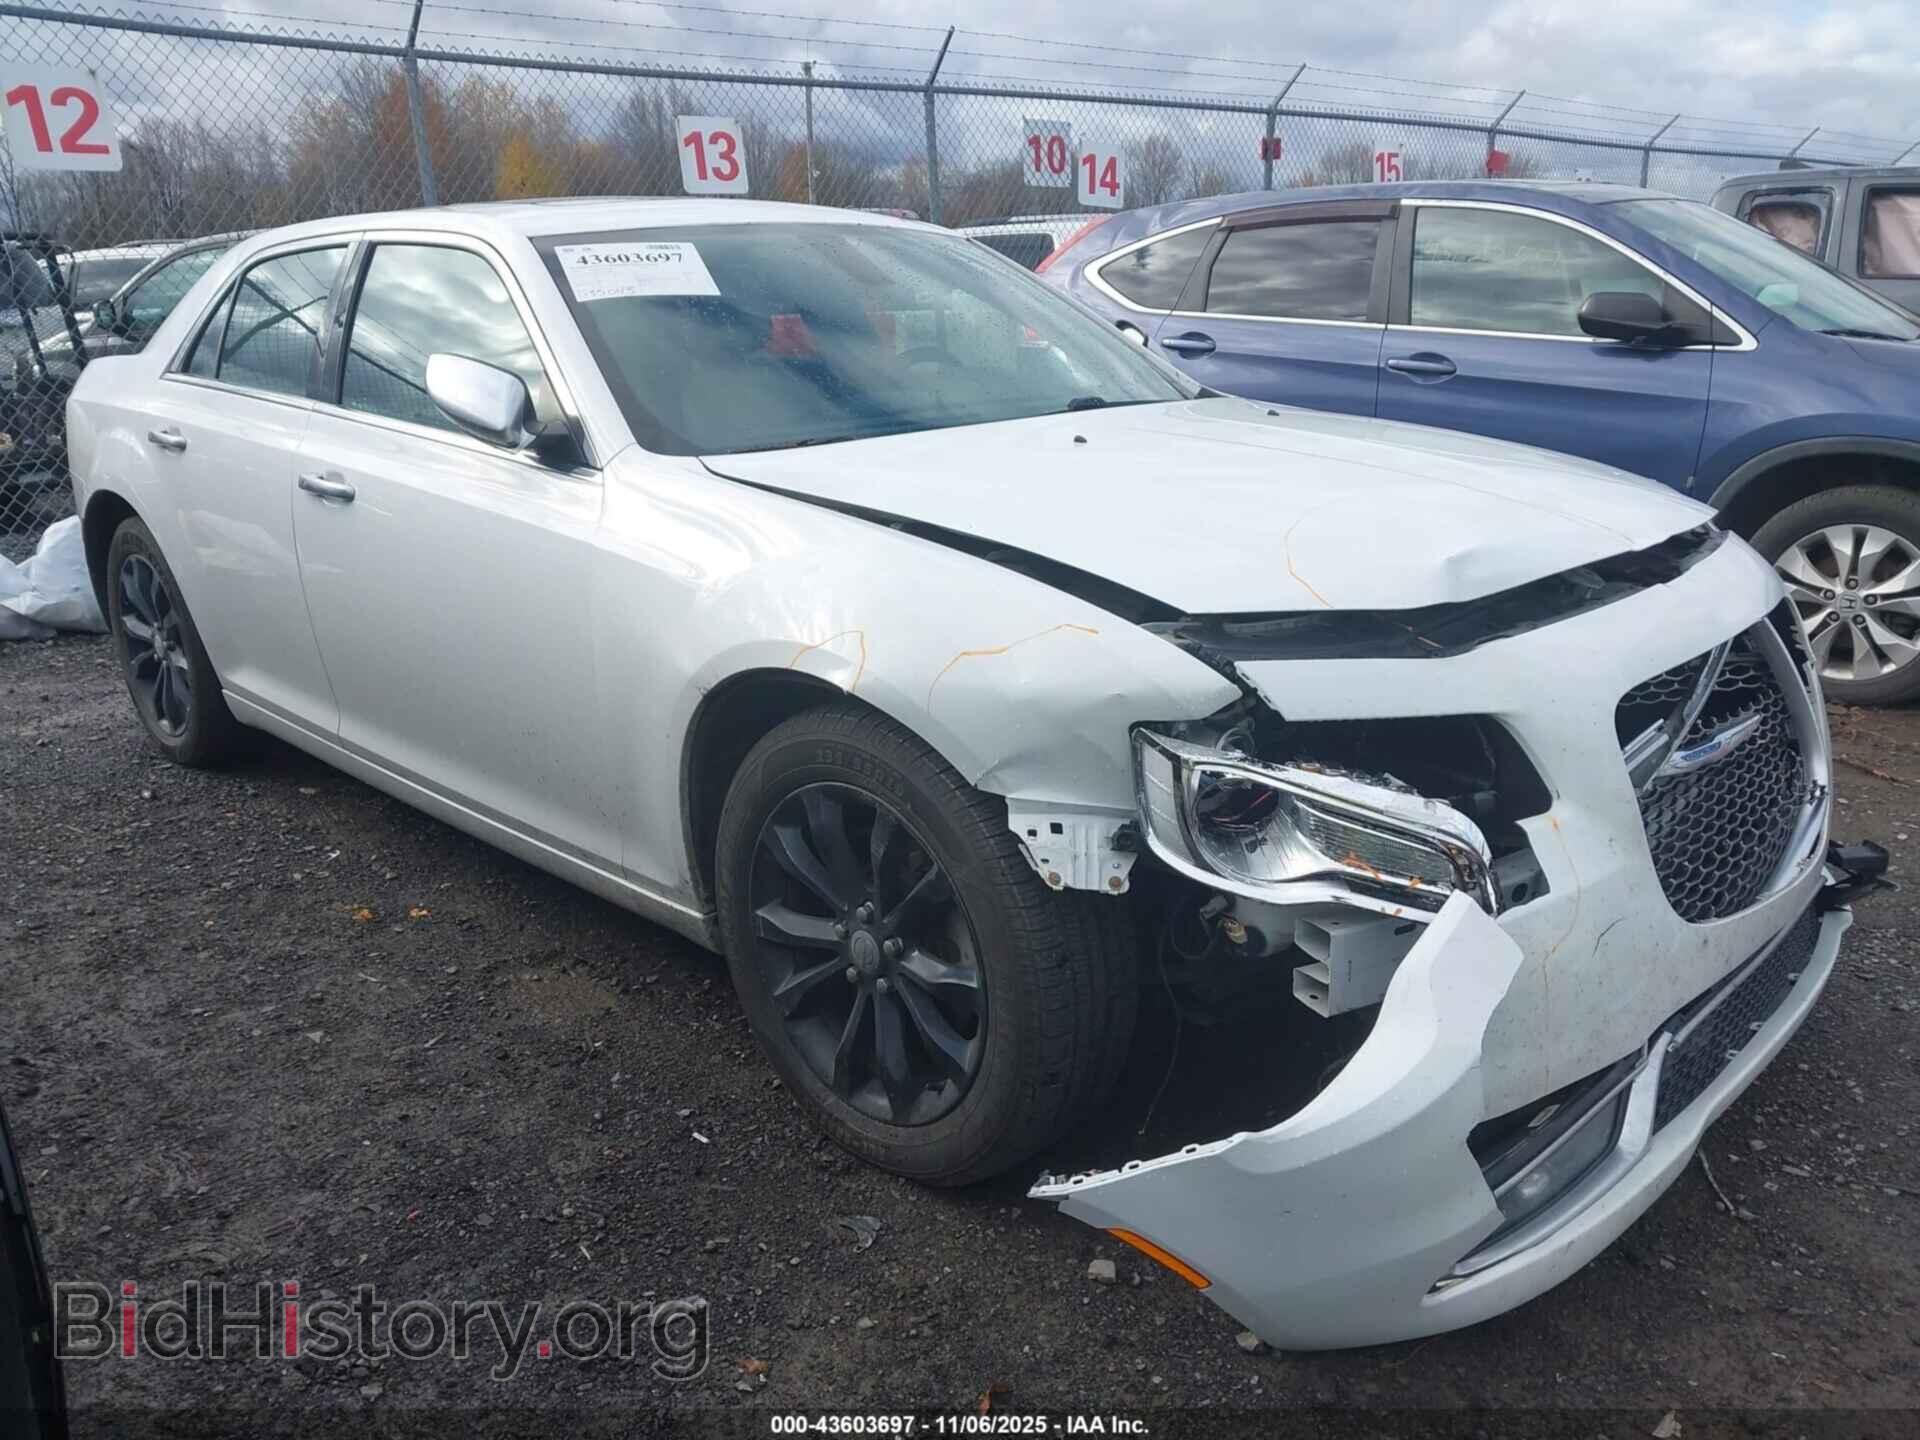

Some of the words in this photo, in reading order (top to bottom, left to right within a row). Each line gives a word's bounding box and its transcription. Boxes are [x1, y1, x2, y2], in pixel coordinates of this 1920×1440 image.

[5, 84, 111, 155] 12
[683, 130, 740, 182] 13
[1027, 134, 1067, 174] 10
[1081, 153, 1121, 197] 14
[1375, 151, 1401, 183] 15
[576, 252, 684, 266] 43603697
